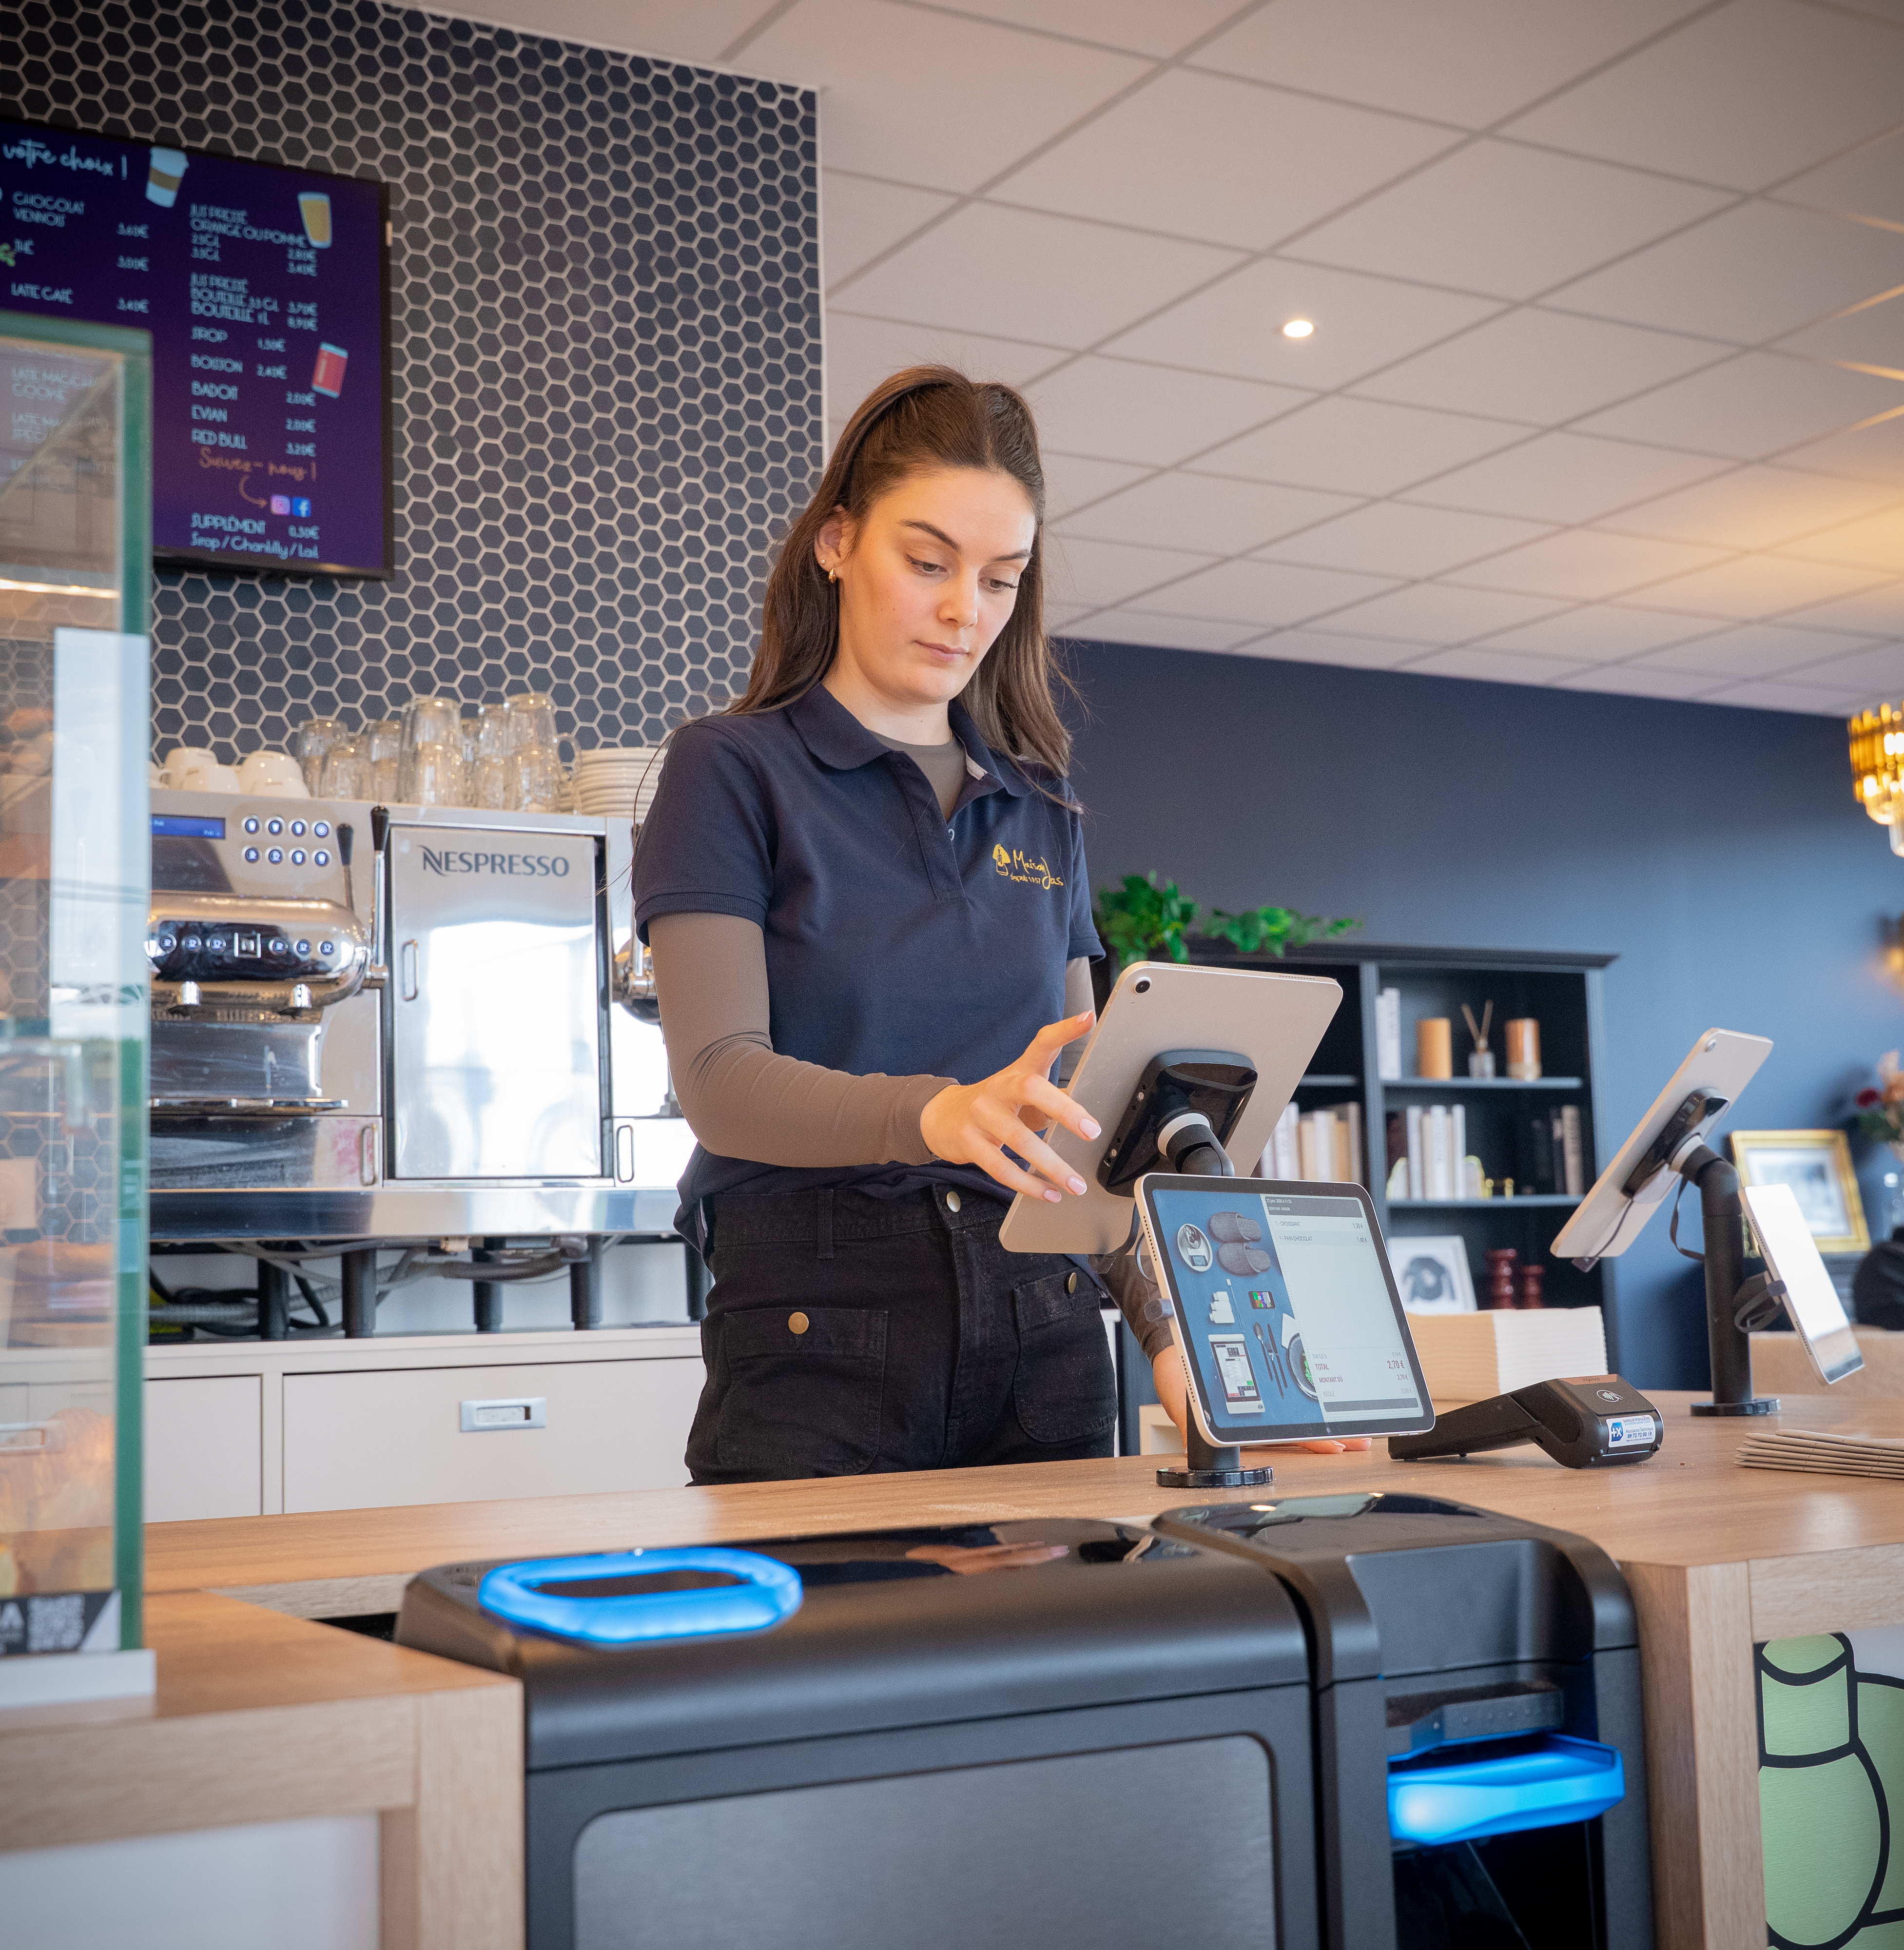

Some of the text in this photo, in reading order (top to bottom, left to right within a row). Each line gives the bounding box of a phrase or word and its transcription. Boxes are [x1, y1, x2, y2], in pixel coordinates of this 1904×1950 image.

[3, 138, 57, 169] votre
[60, 145, 113, 176] choix
[12, 191, 85, 214] CHOCOLAT
[190, 216, 243, 237] ORANGE
[191, 380, 239, 400] BADOIT
[191, 404, 228, 422] EVIAN
[191, 428, 248, 449] RED BULL
[231, 535, 288, 560] Chantilly
[416, 844, 569, 877] NESPRESSO
[1013, 849, 1047, 875] Maison
[1387, 1361, 1399, 1369] 2,70
[1400, 1360, 1404, 1368] €
